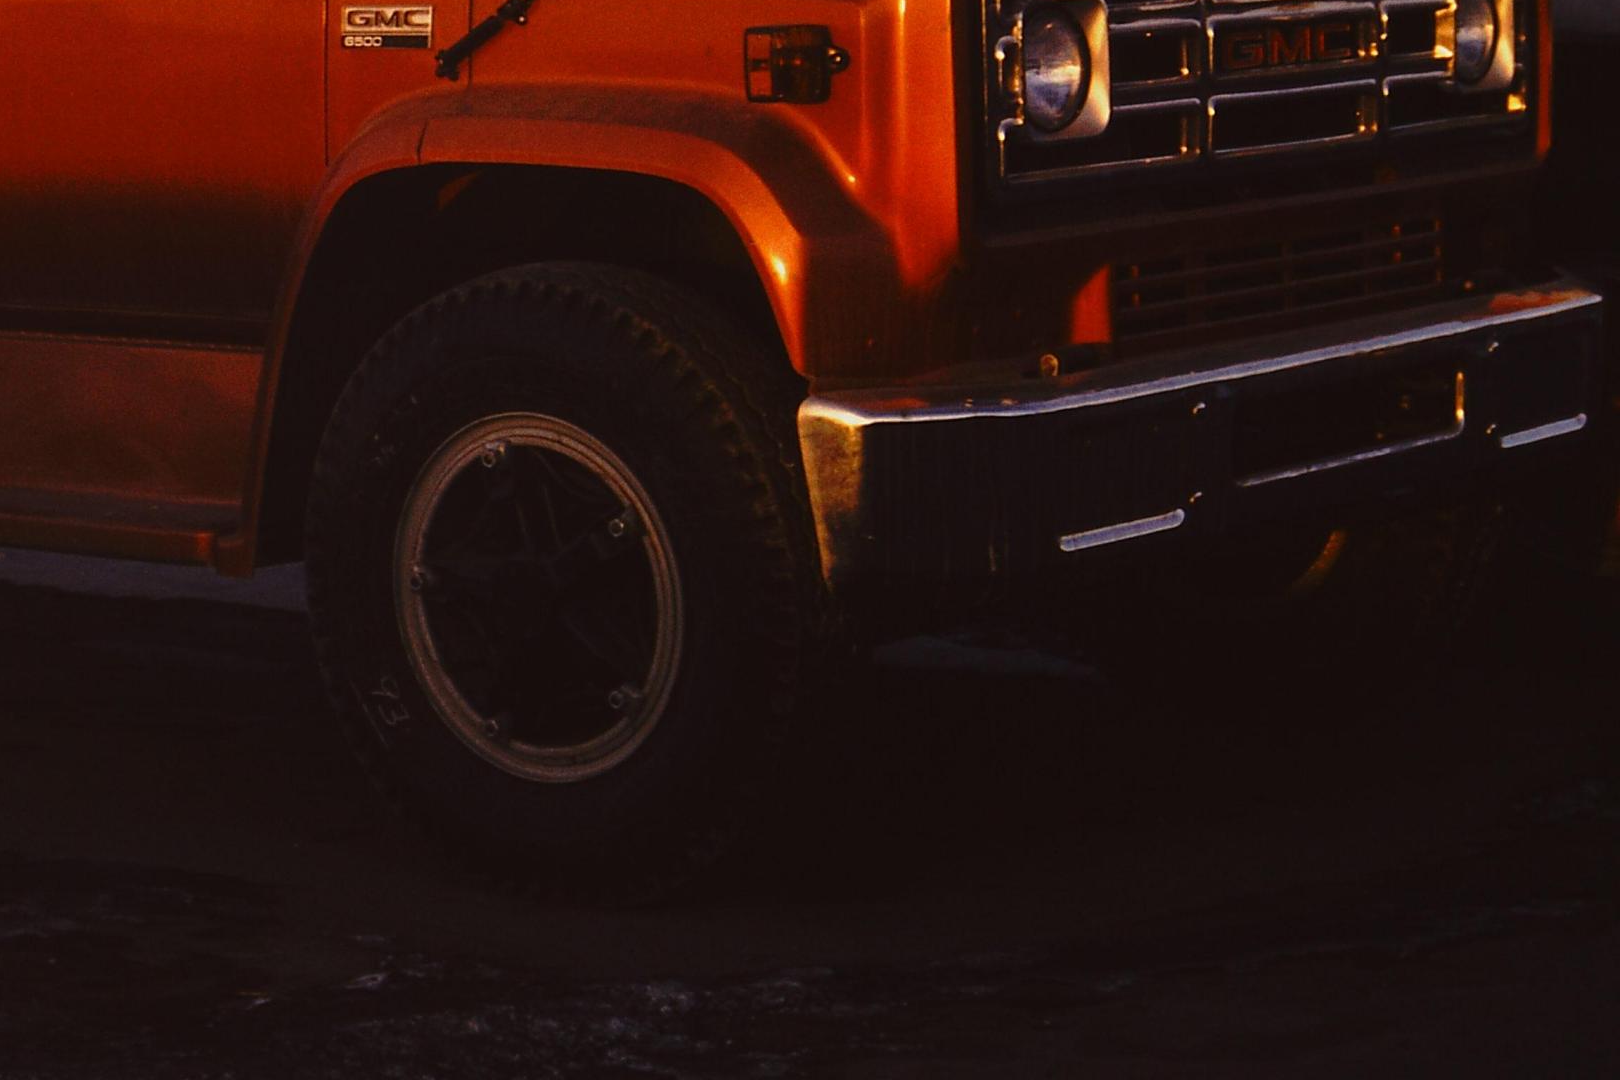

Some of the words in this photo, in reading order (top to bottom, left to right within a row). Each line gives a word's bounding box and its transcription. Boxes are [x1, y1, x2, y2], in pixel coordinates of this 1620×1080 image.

[346, 9, 430, 28] GMC
[343, 35, 383, 47] 6500
[1226, 23, 1354, 69] GMC
